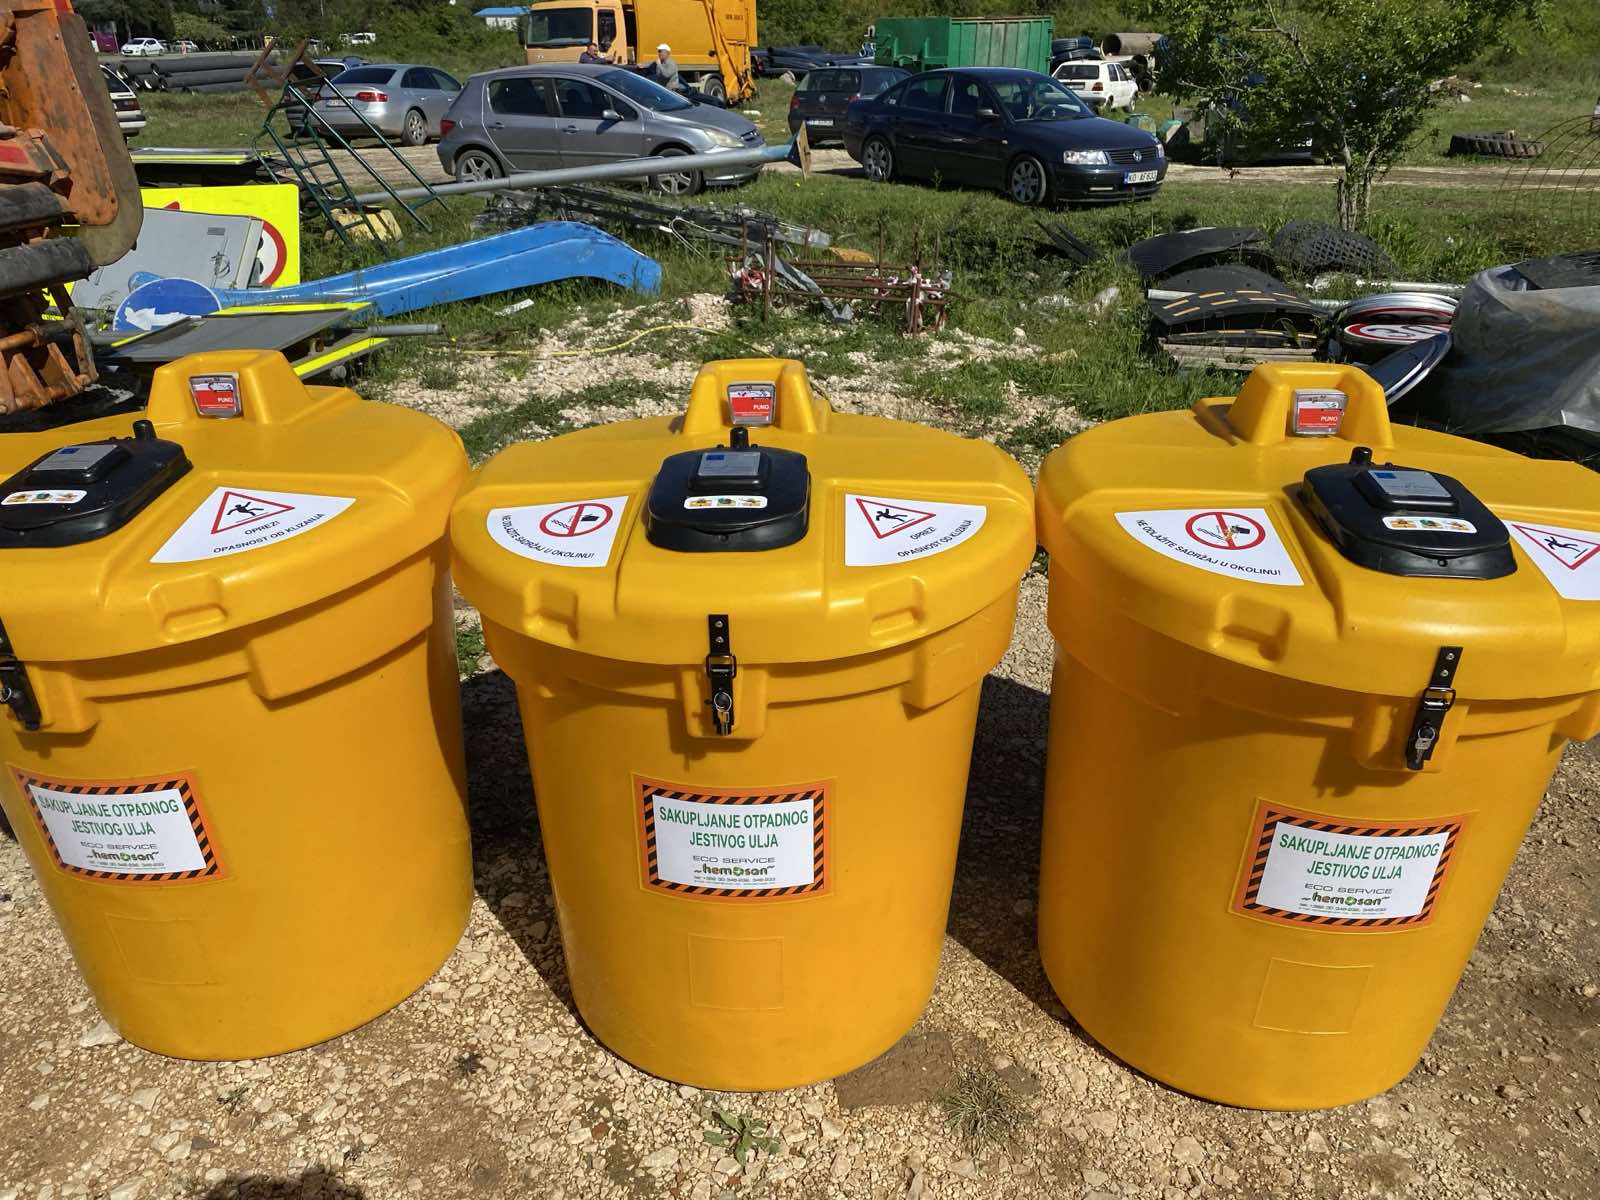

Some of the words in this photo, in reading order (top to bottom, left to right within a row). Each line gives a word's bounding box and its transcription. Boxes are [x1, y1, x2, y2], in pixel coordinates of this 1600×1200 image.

[213, 536, 268, 553] OPASNOST
[270, 531, 285, 539] OD
[285, 513, 326, 533] KLIZANJA
[245, 521, 281, 535] OPREZ!
[552, 549, 595, 559] OKOLINU!
[1175, 545, 1218, 564] SADRŽAJ
[1229, 563, 1281, 576] OKOLINU!
[38, 795, 111, 817] SAKUPLJANJE
[112, 799, 180, 817] OTPADNOG
[659, 806, 740, 828] SAKUPLJANJE
[743, 810, 808, 828] OTPADNOG
[71, 819, 122, 836] JESTIVOG
[124, 821, 156, 836] ULJA
[80, 841, 104, 849] ECO
[690, 832, 745, 848] JESTIVOG
[748, 834, 779, 848] ULJA
[1279, 833, 1375, 860] SAKUPLJANJE
[1374, 843, 1440, 860] OTPADNOG
[693, 855, 719, 863] ECO
[1307, 860, 1370, 879] JESTIVOG
[1371, 865, 1402, 880] ULJA
[1304, 883, 1334, 892] ECO
[1337, 887, 1393, 895] SERVICE
